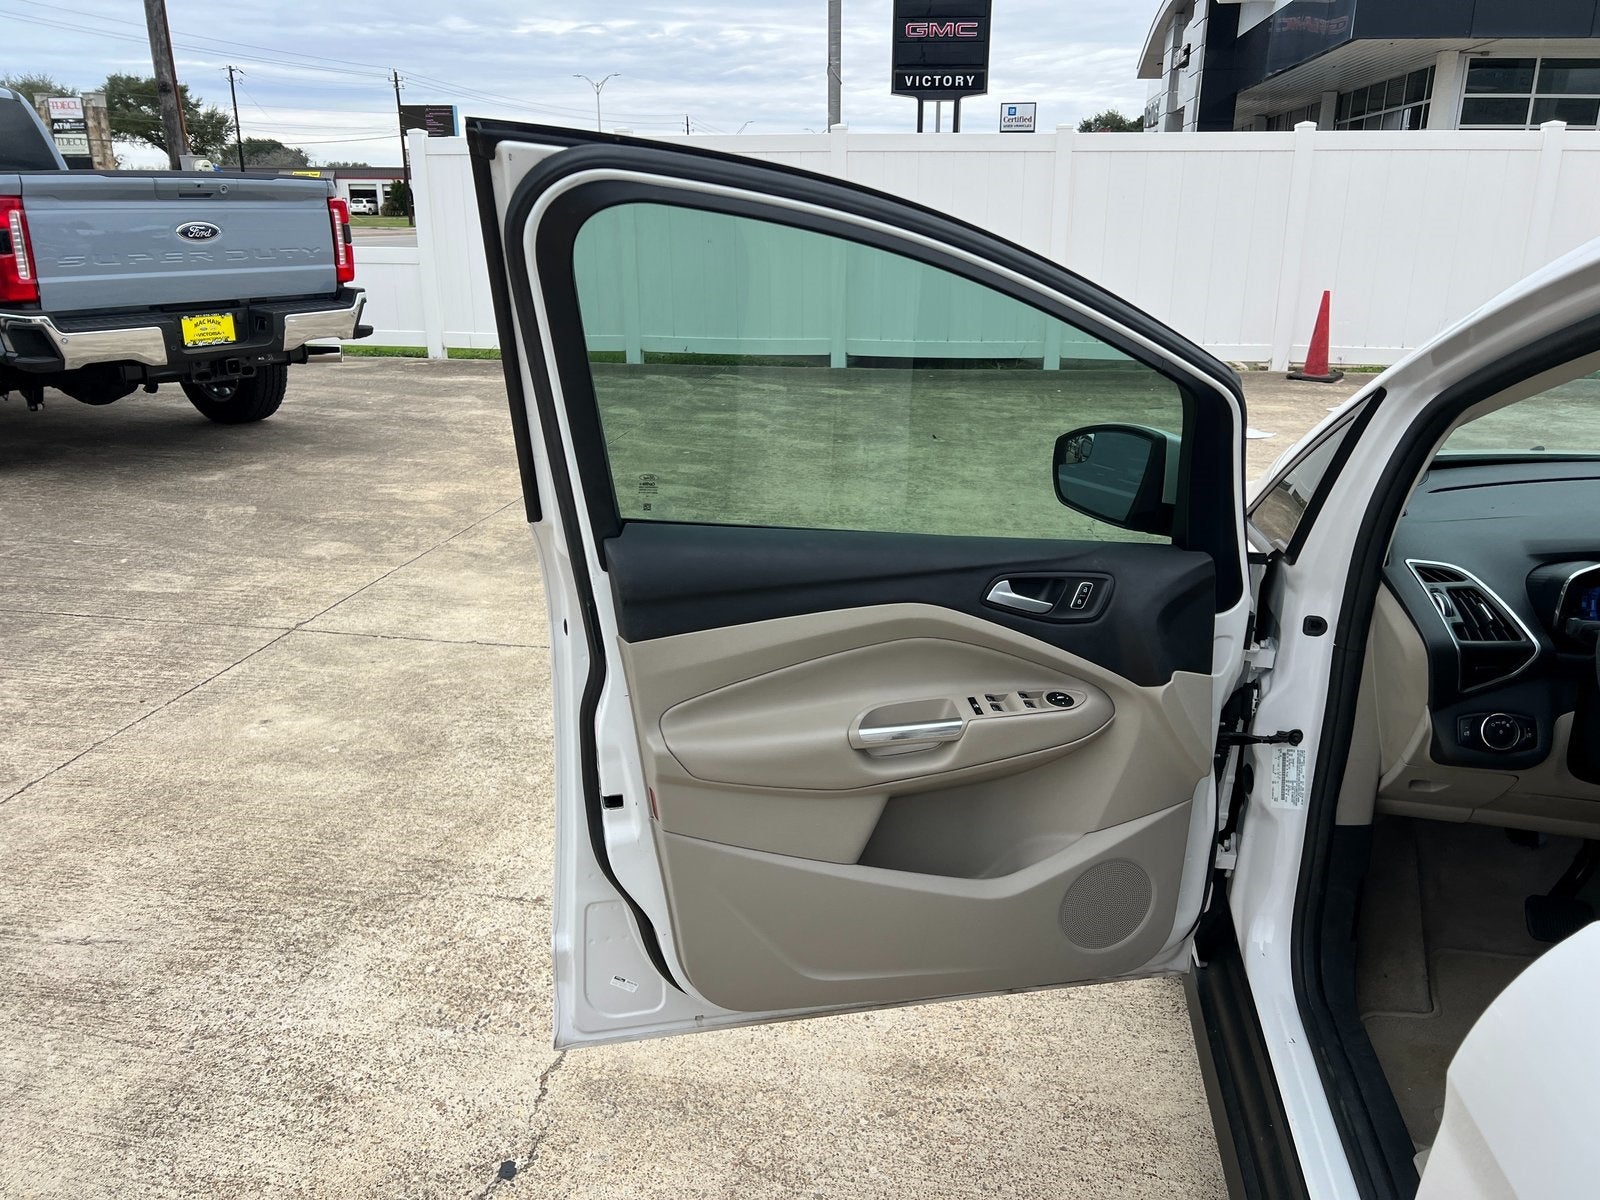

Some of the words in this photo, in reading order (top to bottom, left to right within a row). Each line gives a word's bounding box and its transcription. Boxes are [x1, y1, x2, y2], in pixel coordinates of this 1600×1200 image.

[905, 22, 979, 38] GMC
[904, 75, 976, 87] VICTORY
[1003, 115, 1033, 124] Certified
[187, 226, 212, 239] Ford
[57, 250, 214, 268] SUPER
[225, 247, 322, 262] DUTY
[194, 318, 206, 328] MAC
